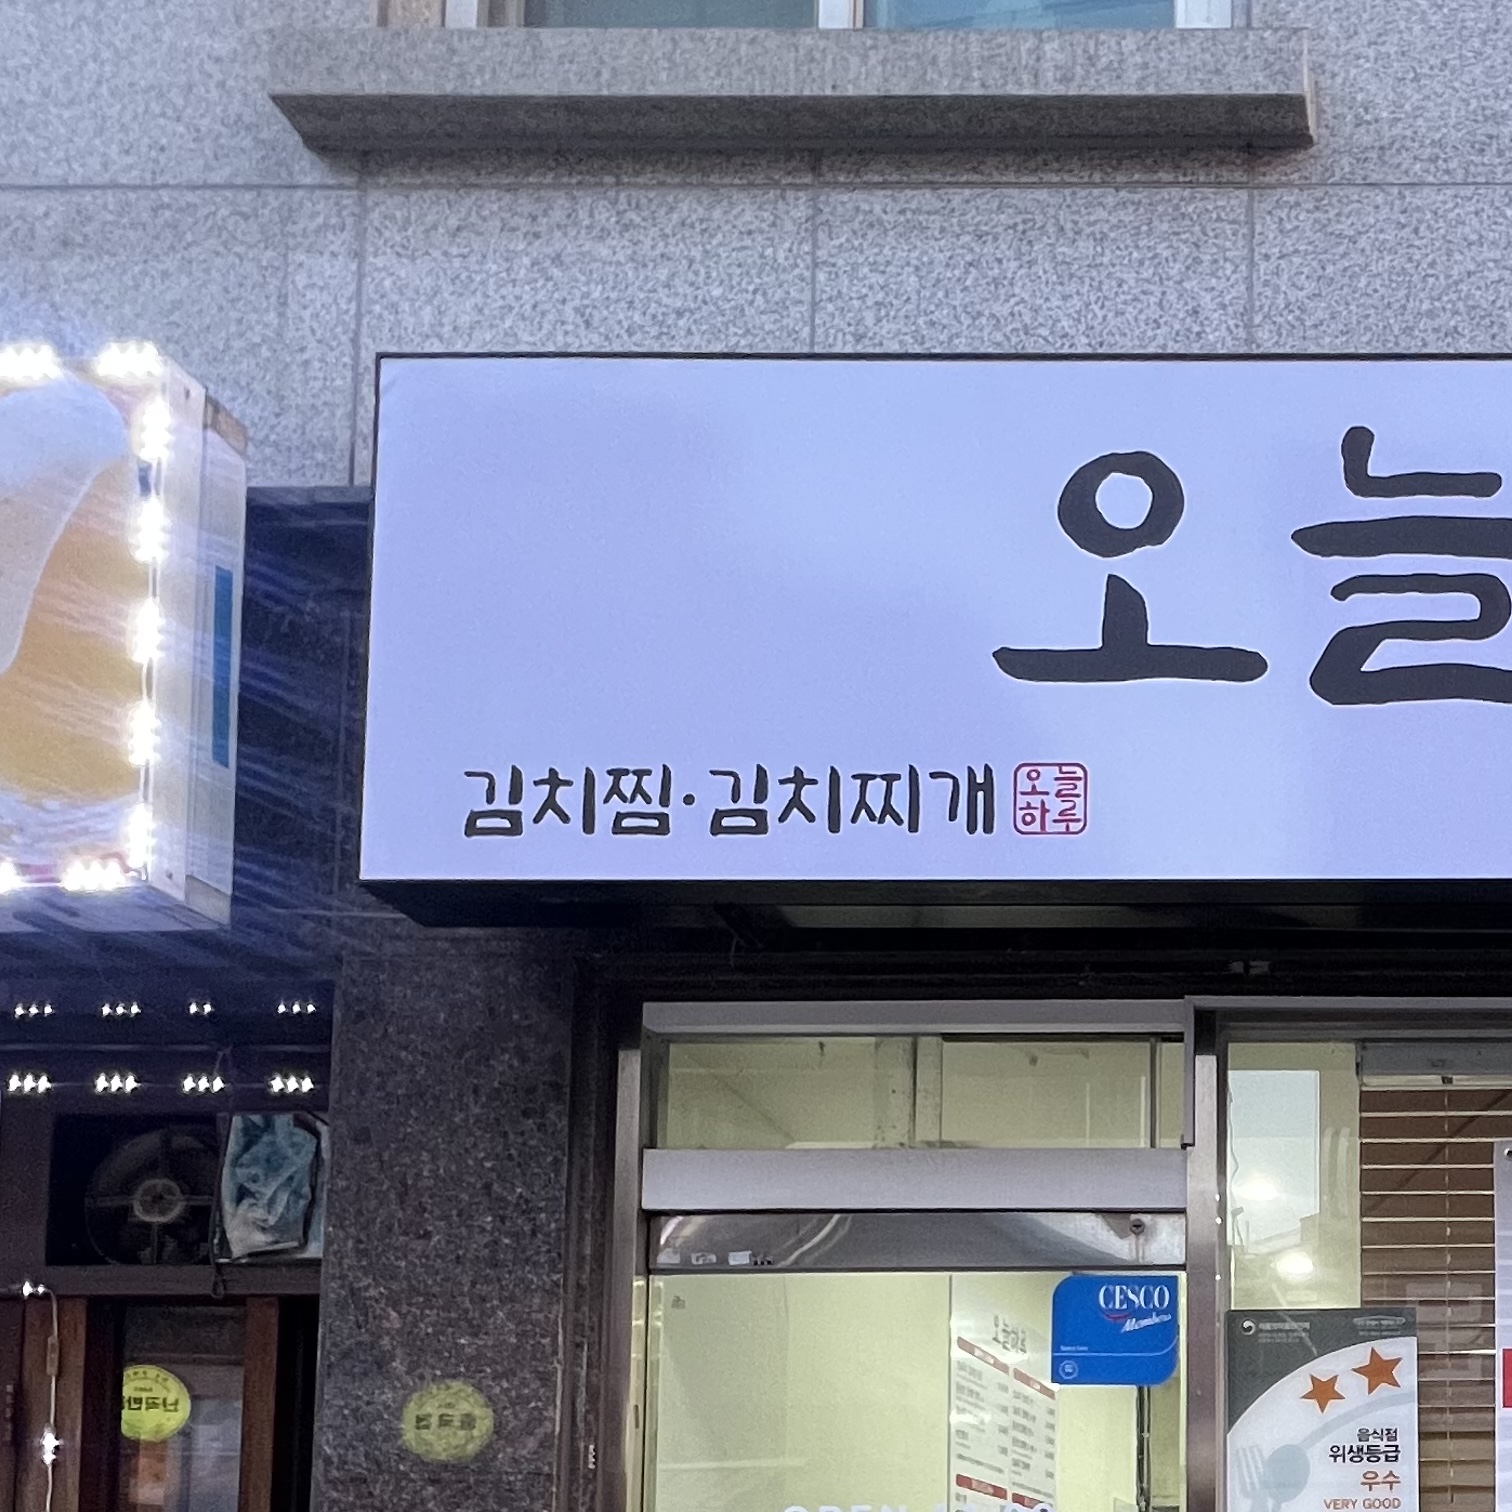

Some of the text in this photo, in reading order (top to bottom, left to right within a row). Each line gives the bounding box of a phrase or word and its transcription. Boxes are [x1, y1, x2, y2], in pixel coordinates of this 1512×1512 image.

[463, 763, 995, 837] 김치찜·김치찌개
[1099, 1285, 1170, 1310] CESCO
[1357, 1428, 1398, 1442] 음식점
[1329, 1445, 1401, 1463] 위생등급
[1360, 1470, 1401, 1491] 우수
[1323, 1498, 1401, 1510] VERY GOOD
